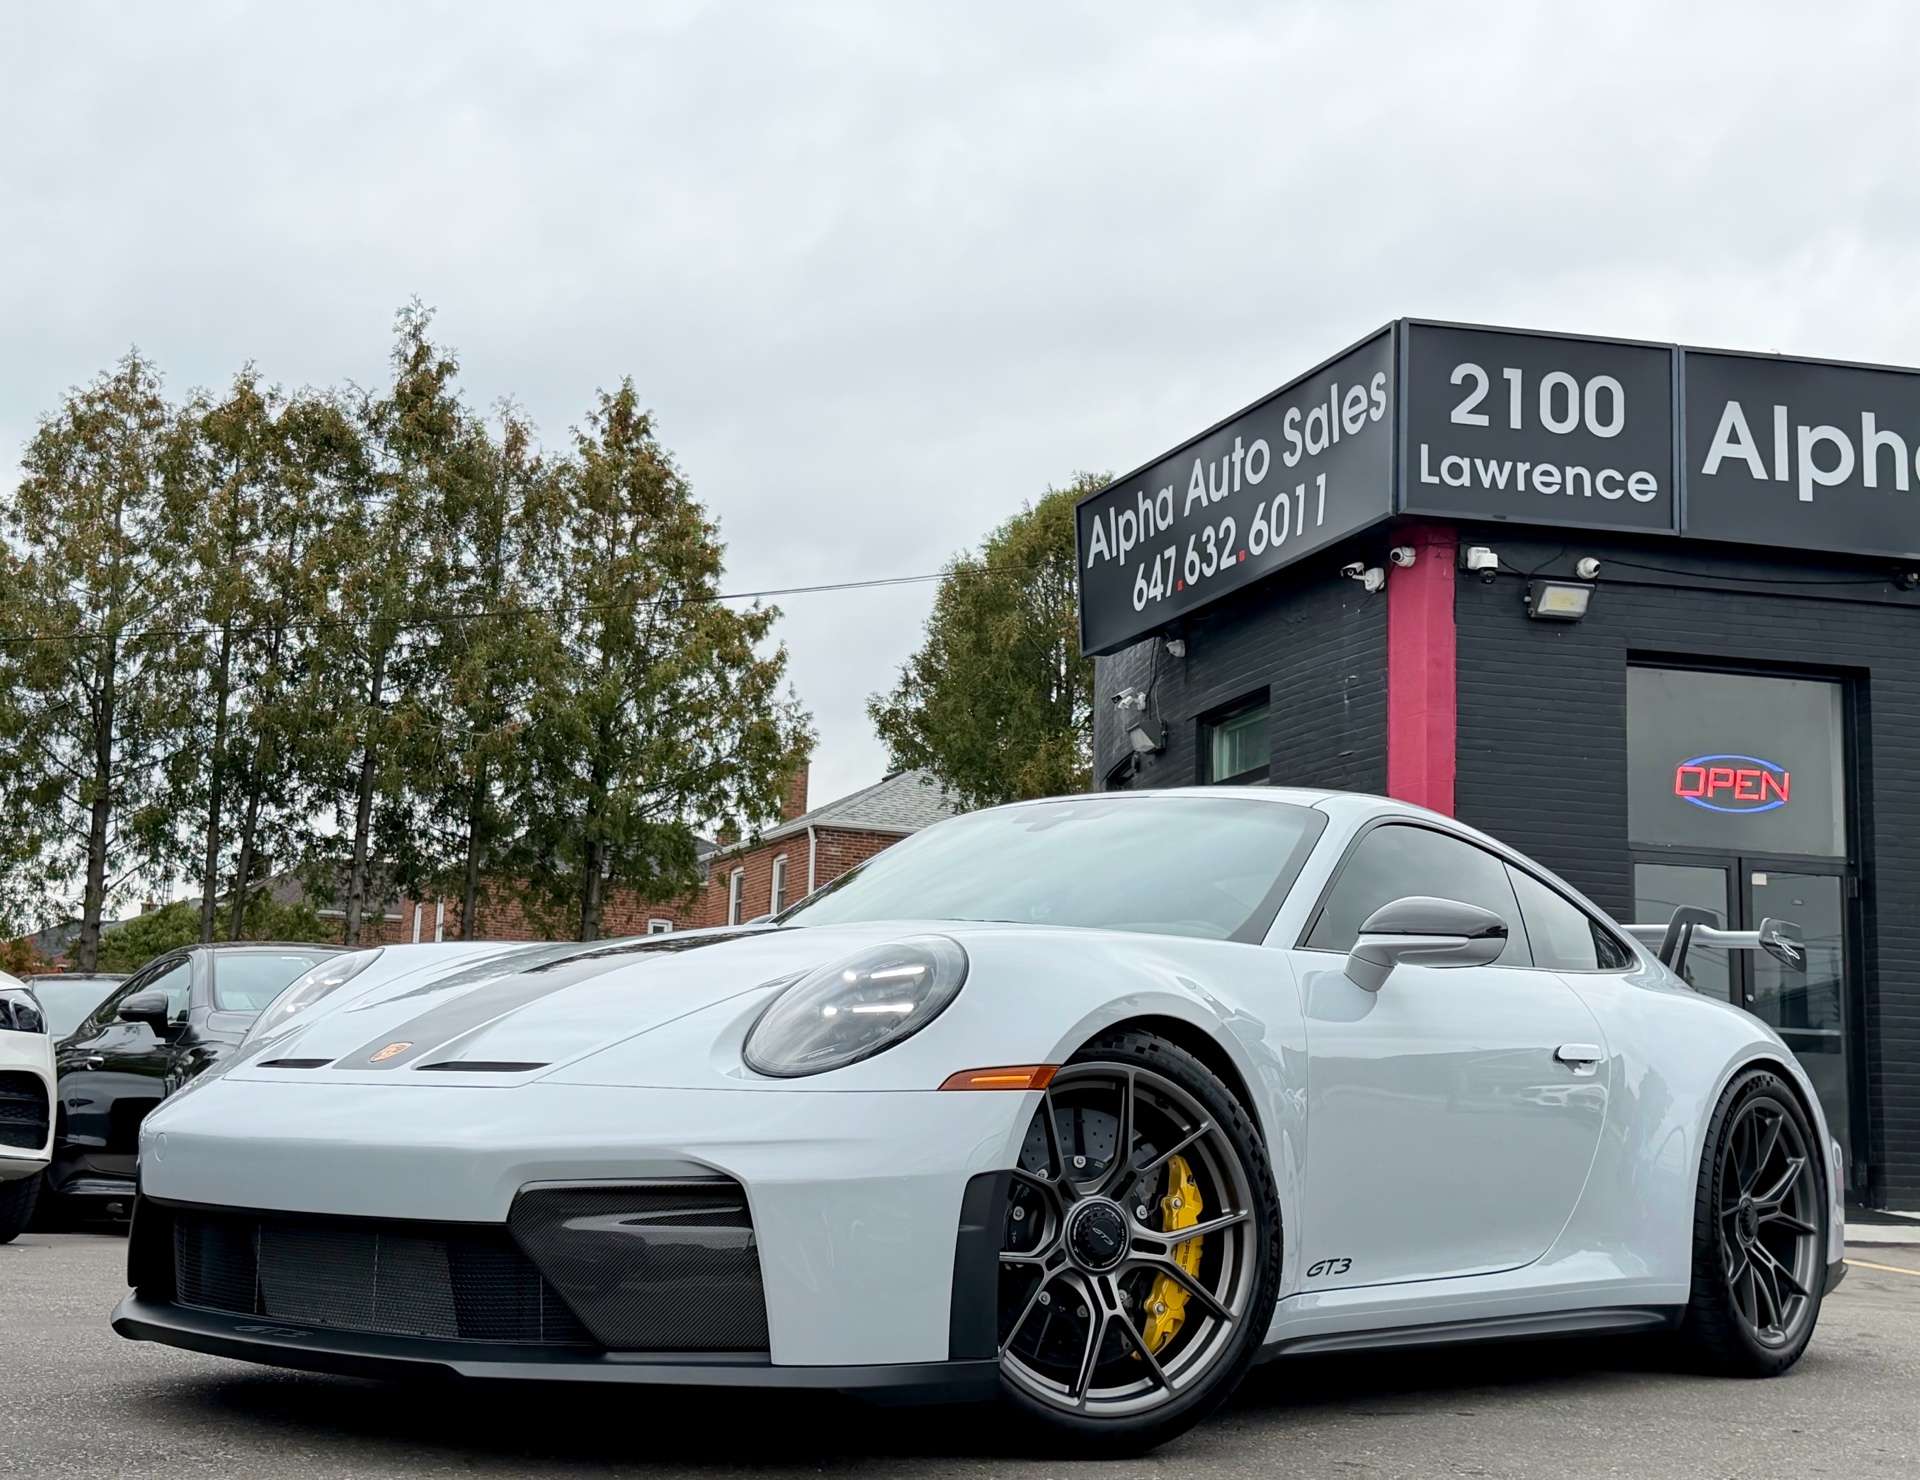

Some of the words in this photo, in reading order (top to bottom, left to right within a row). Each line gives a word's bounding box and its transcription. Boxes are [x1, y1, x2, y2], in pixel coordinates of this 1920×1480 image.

[1450, 362, 1625, 438] 2100
[1087, 484, 1174, 569] Alpha
[1183, 436, 1271, 517] Auto
[1282, 371, 1387, 468] Sales
[1420, 443, 1658, 503] Lawrence
[1701, 400, 1920, 502] Alph
[1133, 472, 1326, 612] 647.632.6011
[1674, 765, 1790, 802] OPEN
[1306, 1258, 1352, 1277] GT3
